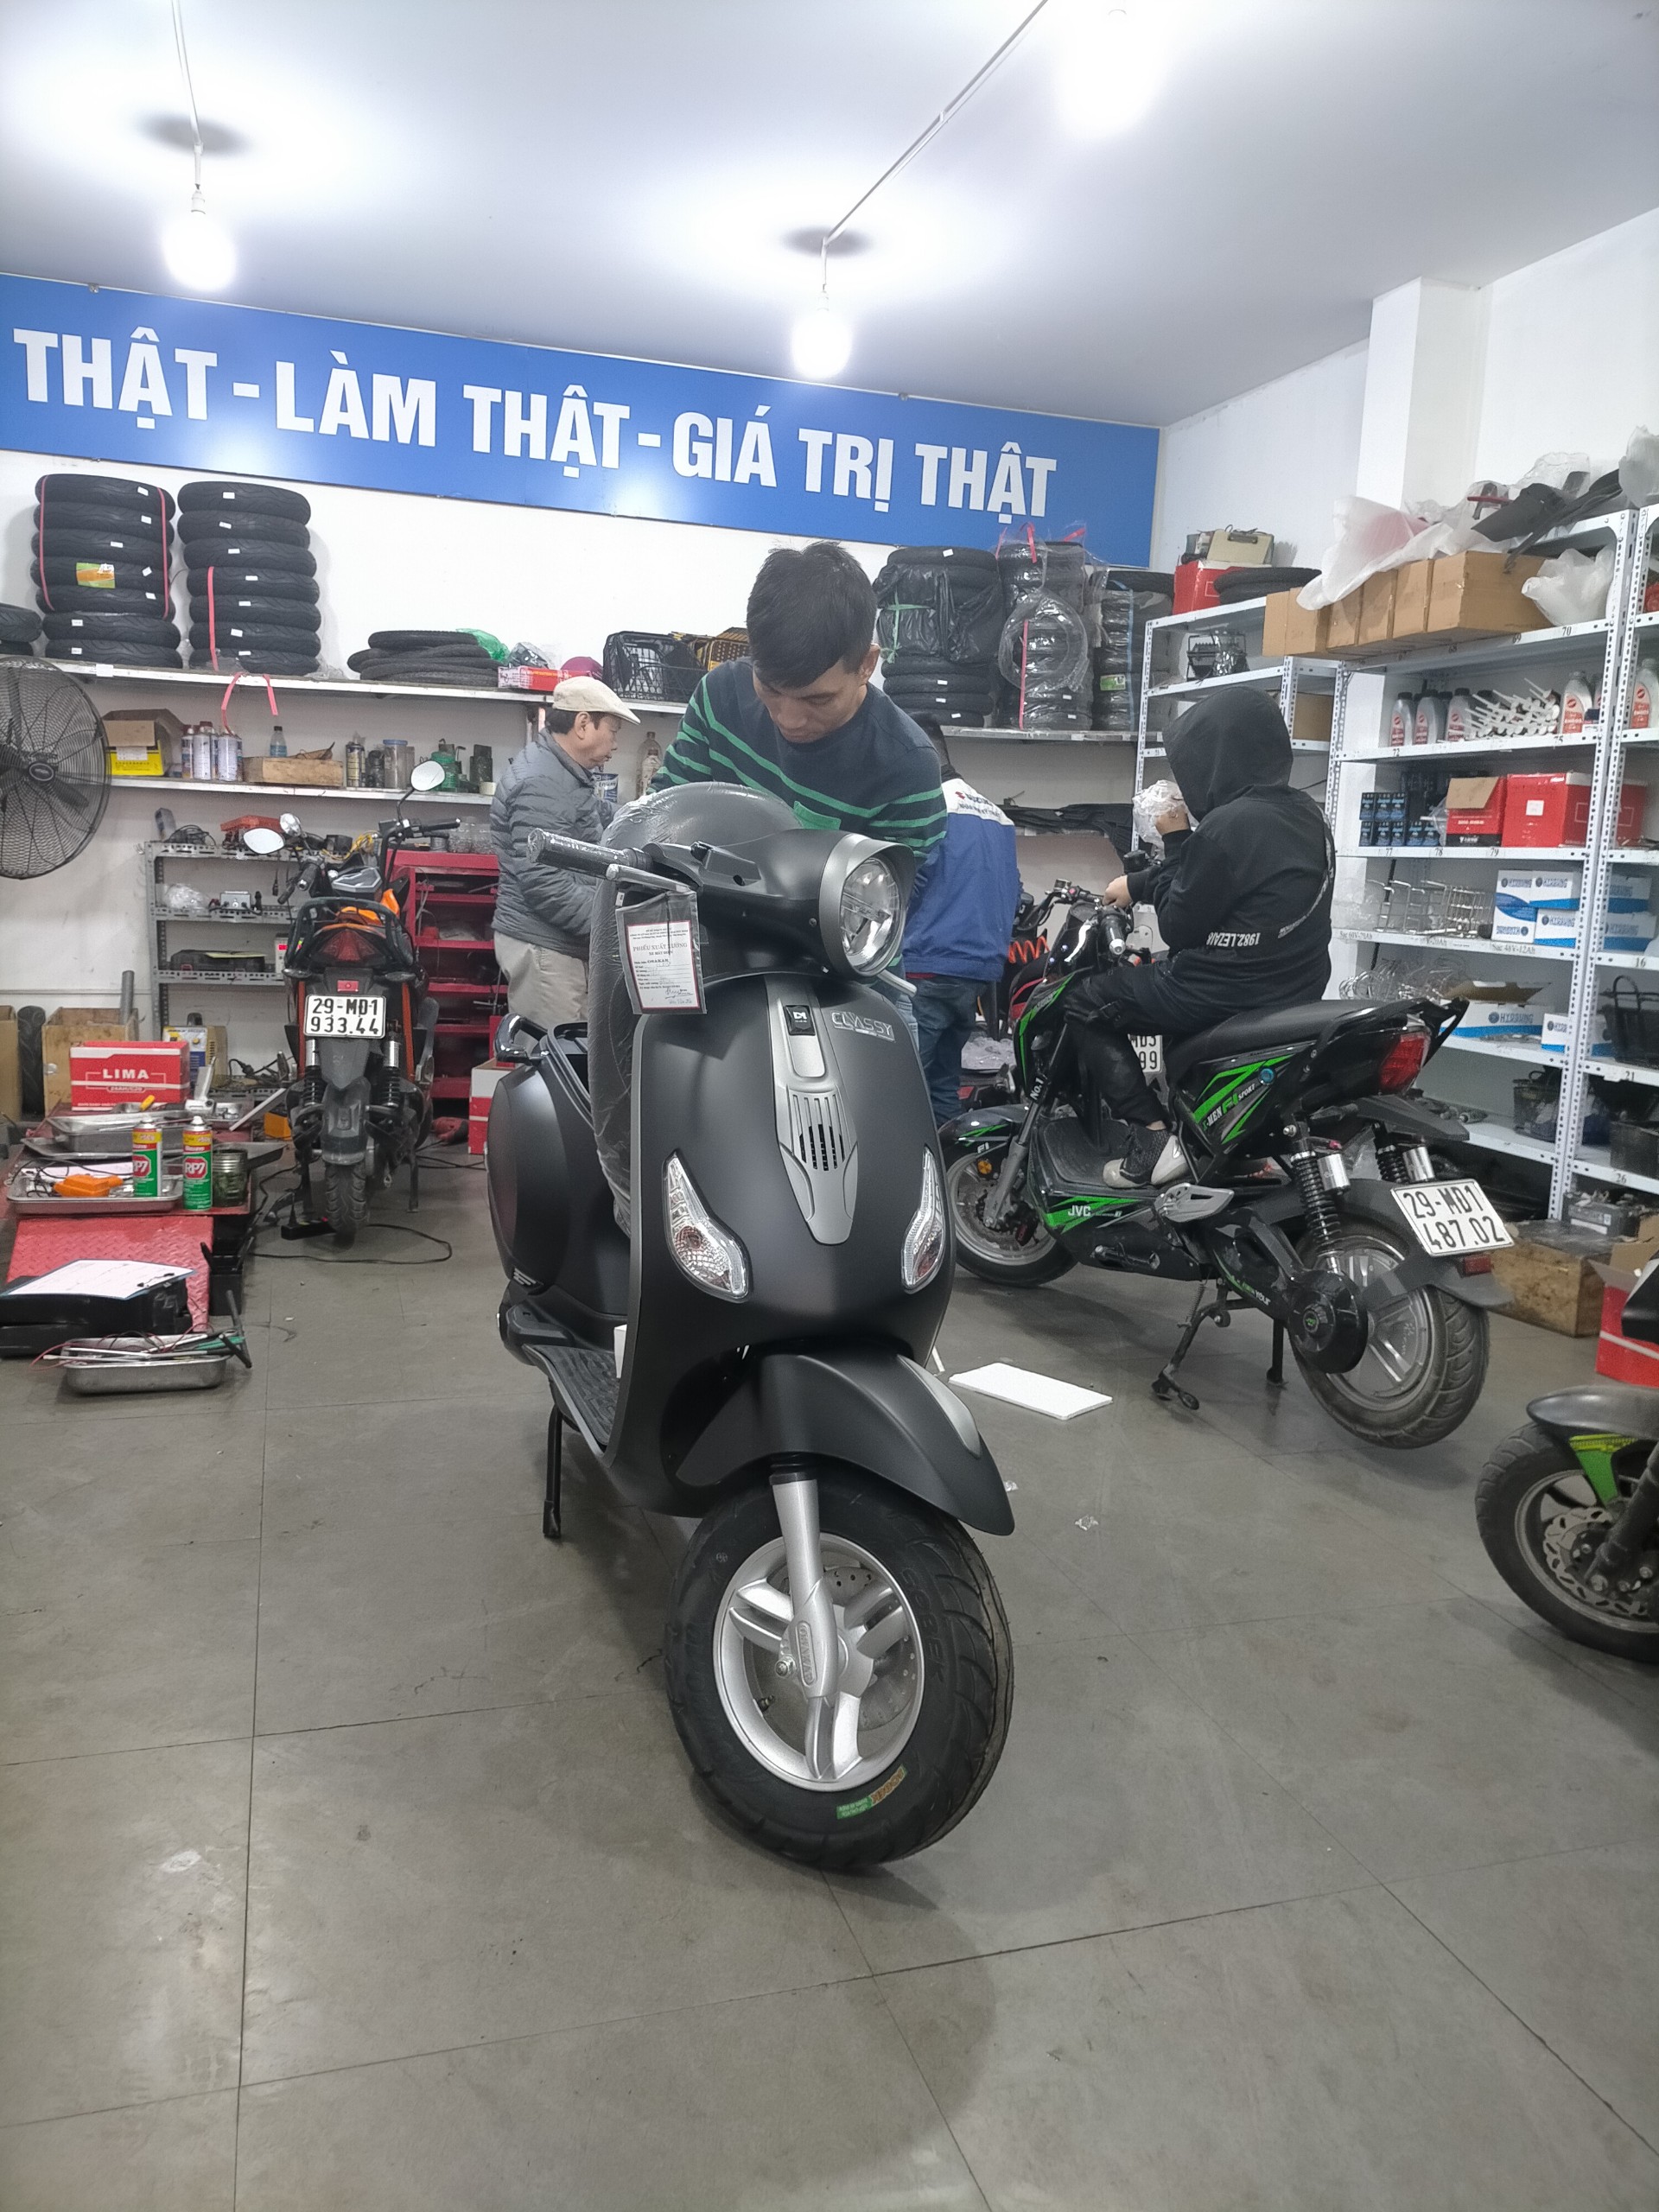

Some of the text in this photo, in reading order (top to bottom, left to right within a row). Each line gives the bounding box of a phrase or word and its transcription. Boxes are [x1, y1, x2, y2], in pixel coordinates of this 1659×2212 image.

[13, 327, 218, 429] THẬT
[276, 350, 436, 448] LÀM
[462, 385, 630, 478] THẬT
[672, 405, 778, 488] GIÁ
[798, 428, 894, 513] TRỊ
[914, 442, 1058, 524] THẬT
[1561, 626, 1572, 637] 70
[1434, 848, 1444, 856] 78
[1490, 847, 1499, 856] 79
[1635, 957, 1647, 968] 16
[310, 1016, 378, 1034] 933.44
[831, 1011, 893, 1036] CLASSY
[103, 1069, 149, 1079] LIMA
[1029, 1077, 1045, 1100] No.1
[184, 1161, 206, 1175] RP7
[1616, 1173, 1627, 1185] 26
[1067, 1205, 1091, 1217] JVC
[1423, 1216, 1505, 1249] 487.02
